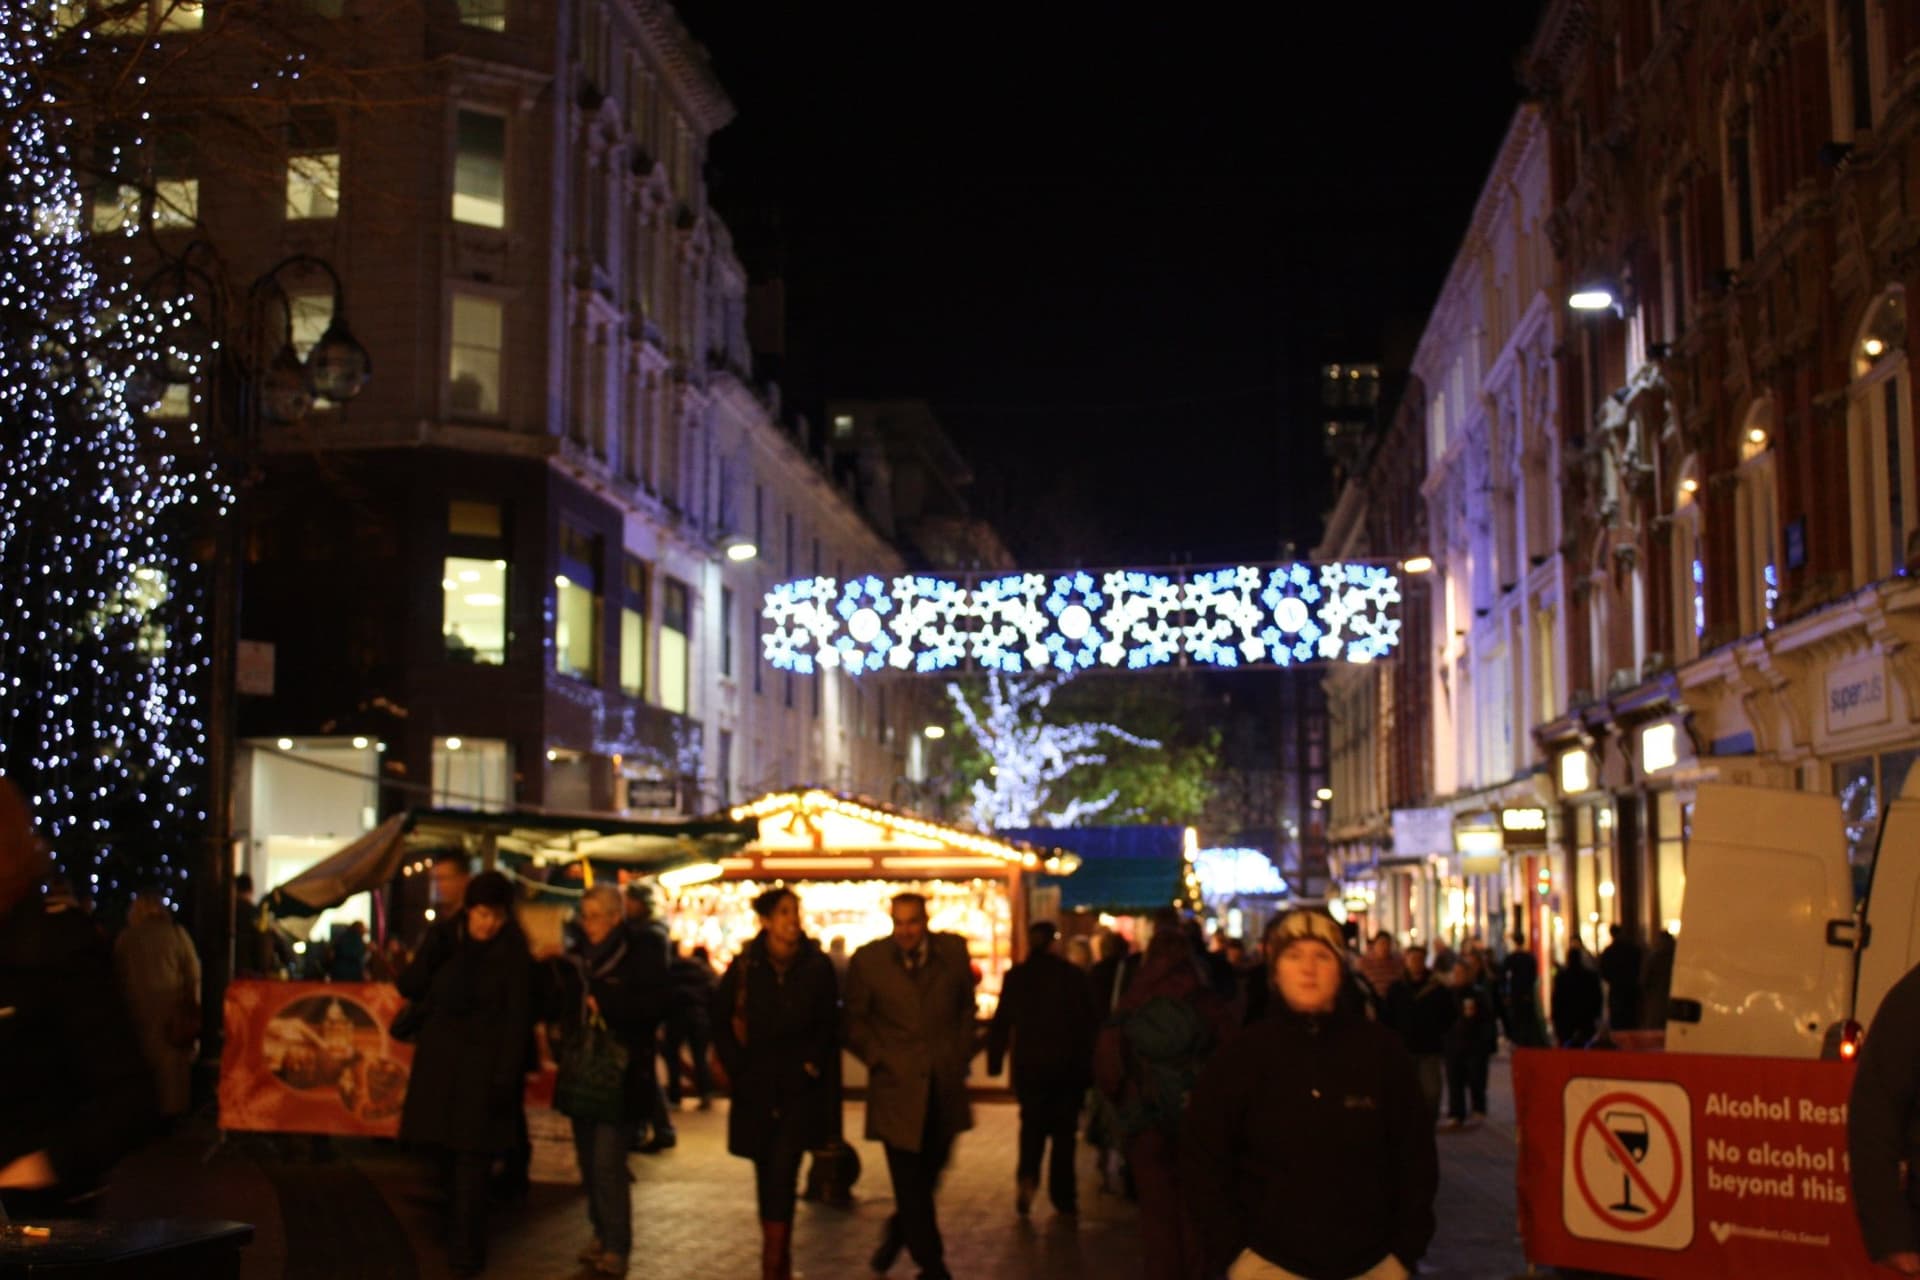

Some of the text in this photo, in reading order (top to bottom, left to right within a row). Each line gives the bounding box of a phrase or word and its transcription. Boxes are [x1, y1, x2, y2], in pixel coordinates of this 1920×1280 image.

[1705, 1093, 1790, 1121] Alcohol
[1707, 1138, 1740, 1163] No
[1747, 1142, 1834, 1172] alcohol
[1708, 1167, 1847, 1204] beyond this
